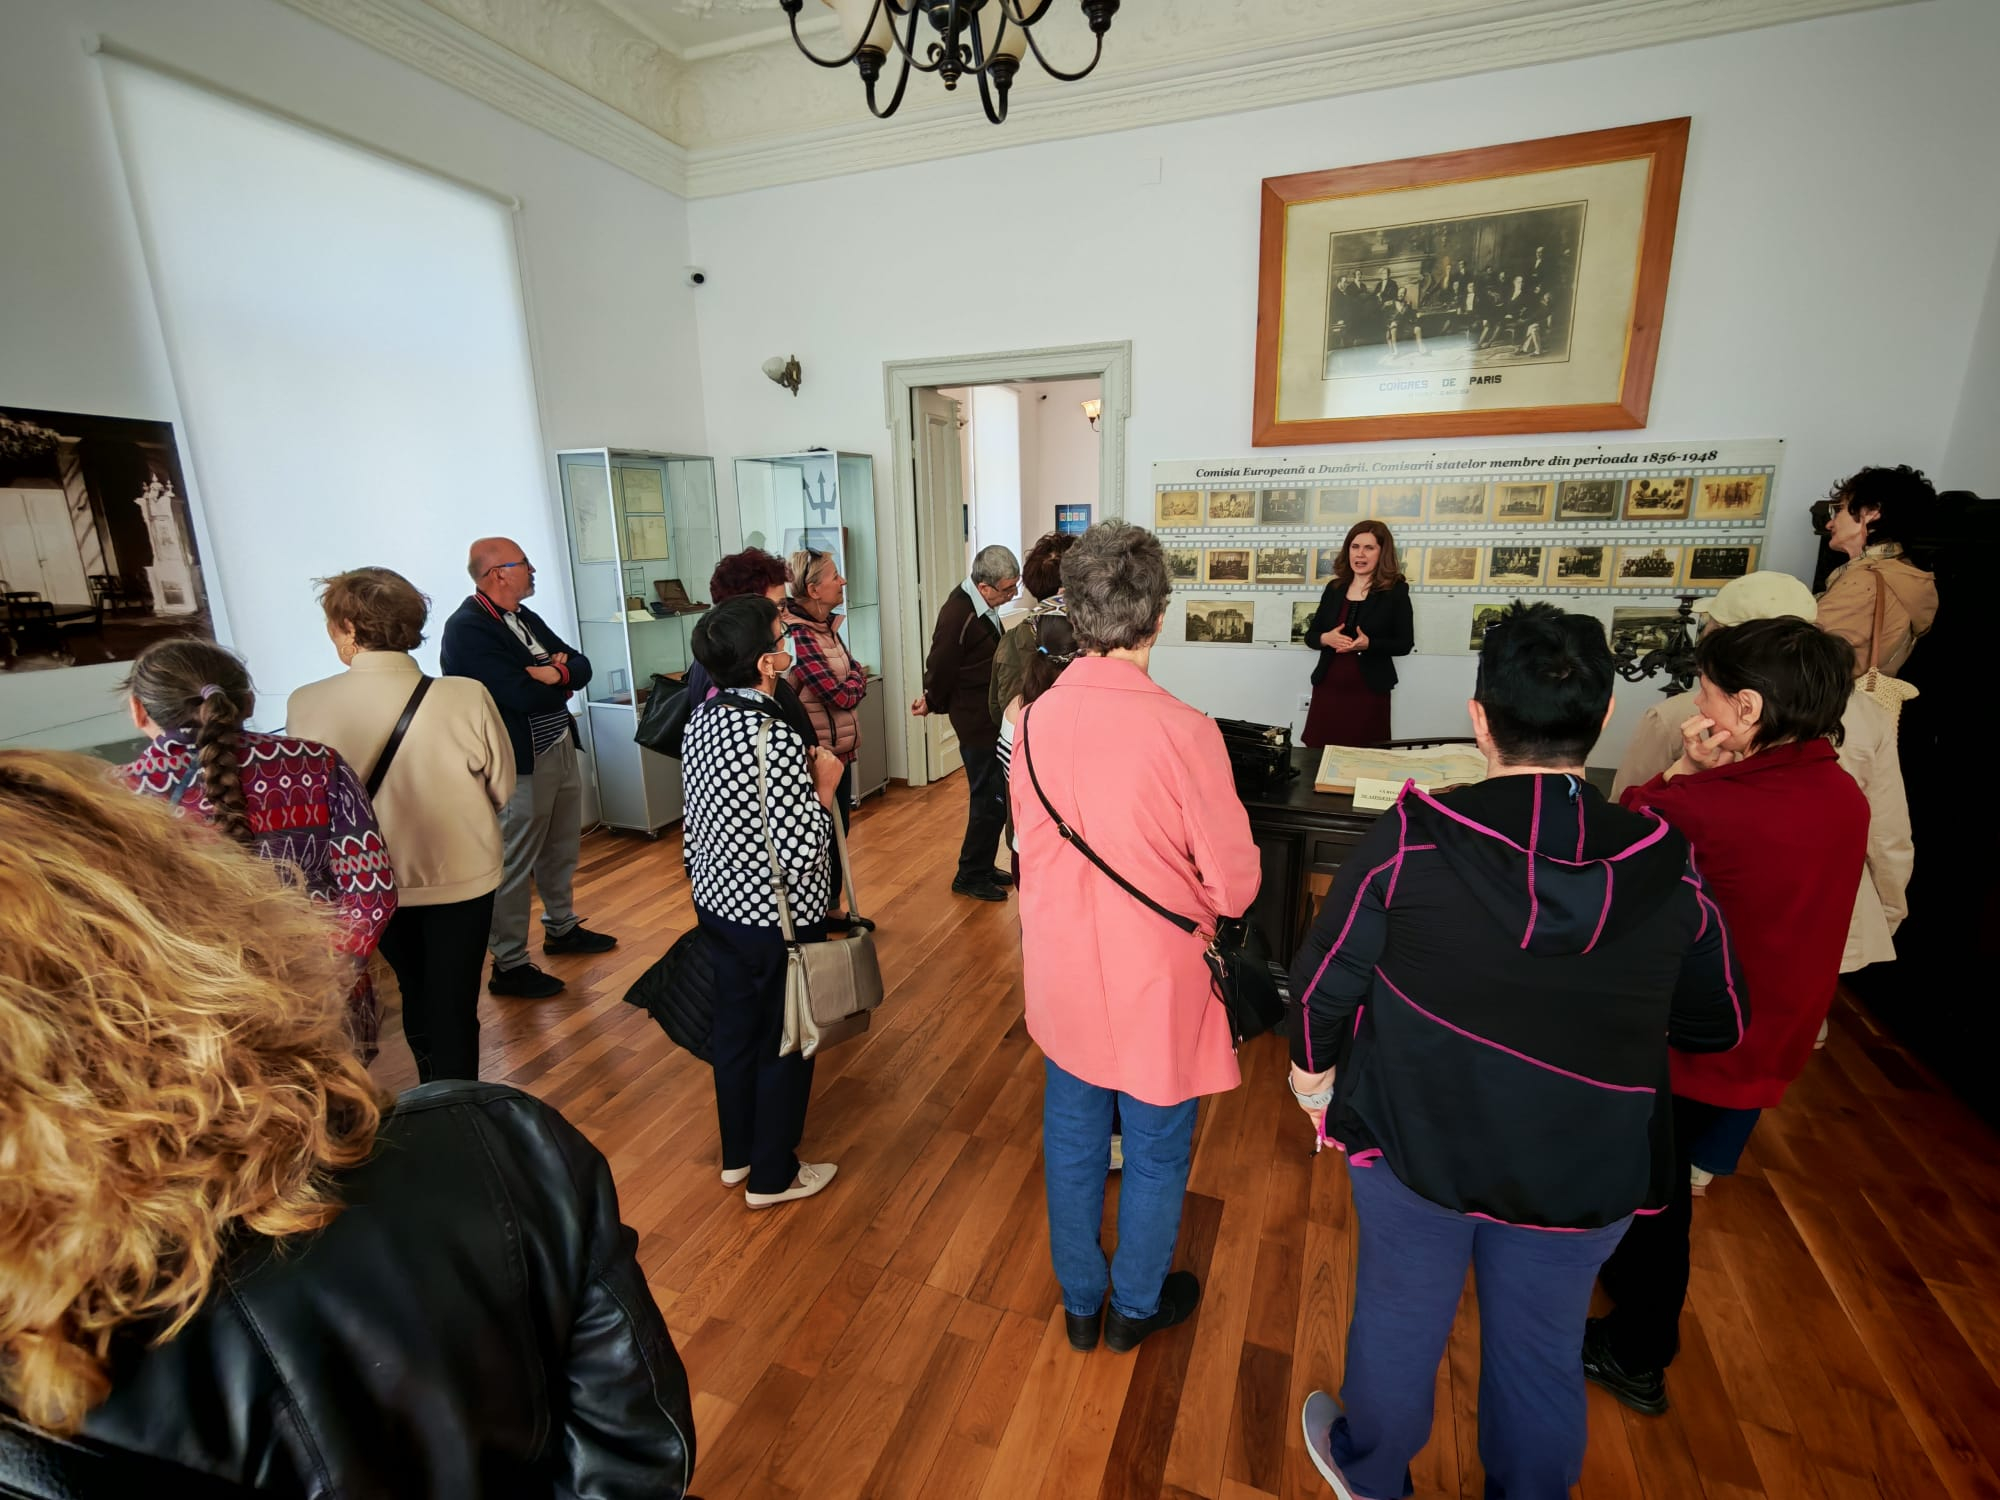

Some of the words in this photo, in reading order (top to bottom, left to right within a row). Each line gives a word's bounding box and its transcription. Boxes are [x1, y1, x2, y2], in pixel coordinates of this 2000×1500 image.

[1442, 378, 1457, 388] DE
[1469, 375, 1503, 385] PARIS
[1196, 468, 1240, 478] Comisia
[1372, 461, 1433, 473] Comisarii
[1436, 459, 1487, 470] statelor
[1490, 457, 1545, 468] membre
[1548, 455, 1571, 466] din
[1573, 453, 1638, 468] perioada
[1642, 450, 1719, 465] 1856-1948
